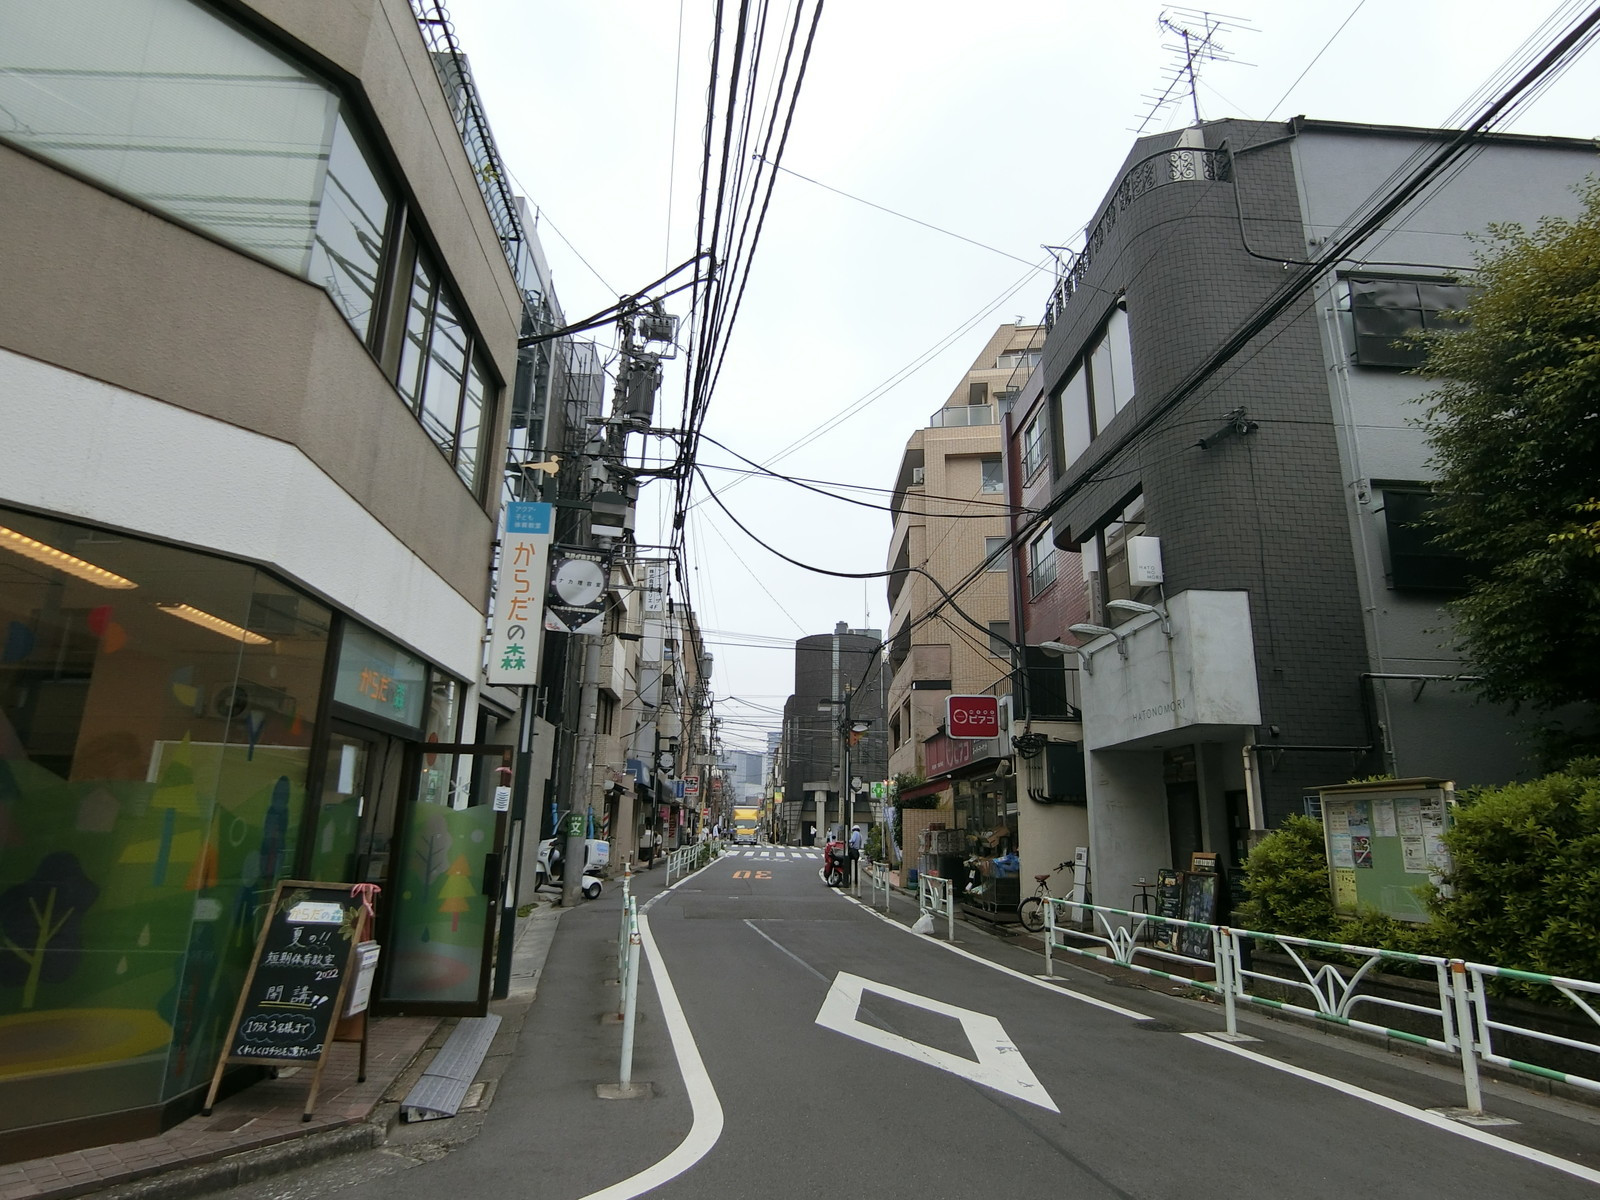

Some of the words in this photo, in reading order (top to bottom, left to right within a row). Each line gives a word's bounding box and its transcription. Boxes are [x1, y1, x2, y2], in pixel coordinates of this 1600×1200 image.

[500, 541, 536, 671] からだの森
[1132, 699, 1186, 722] HATONOMORI
[315, 968, 339, 980] 2022
